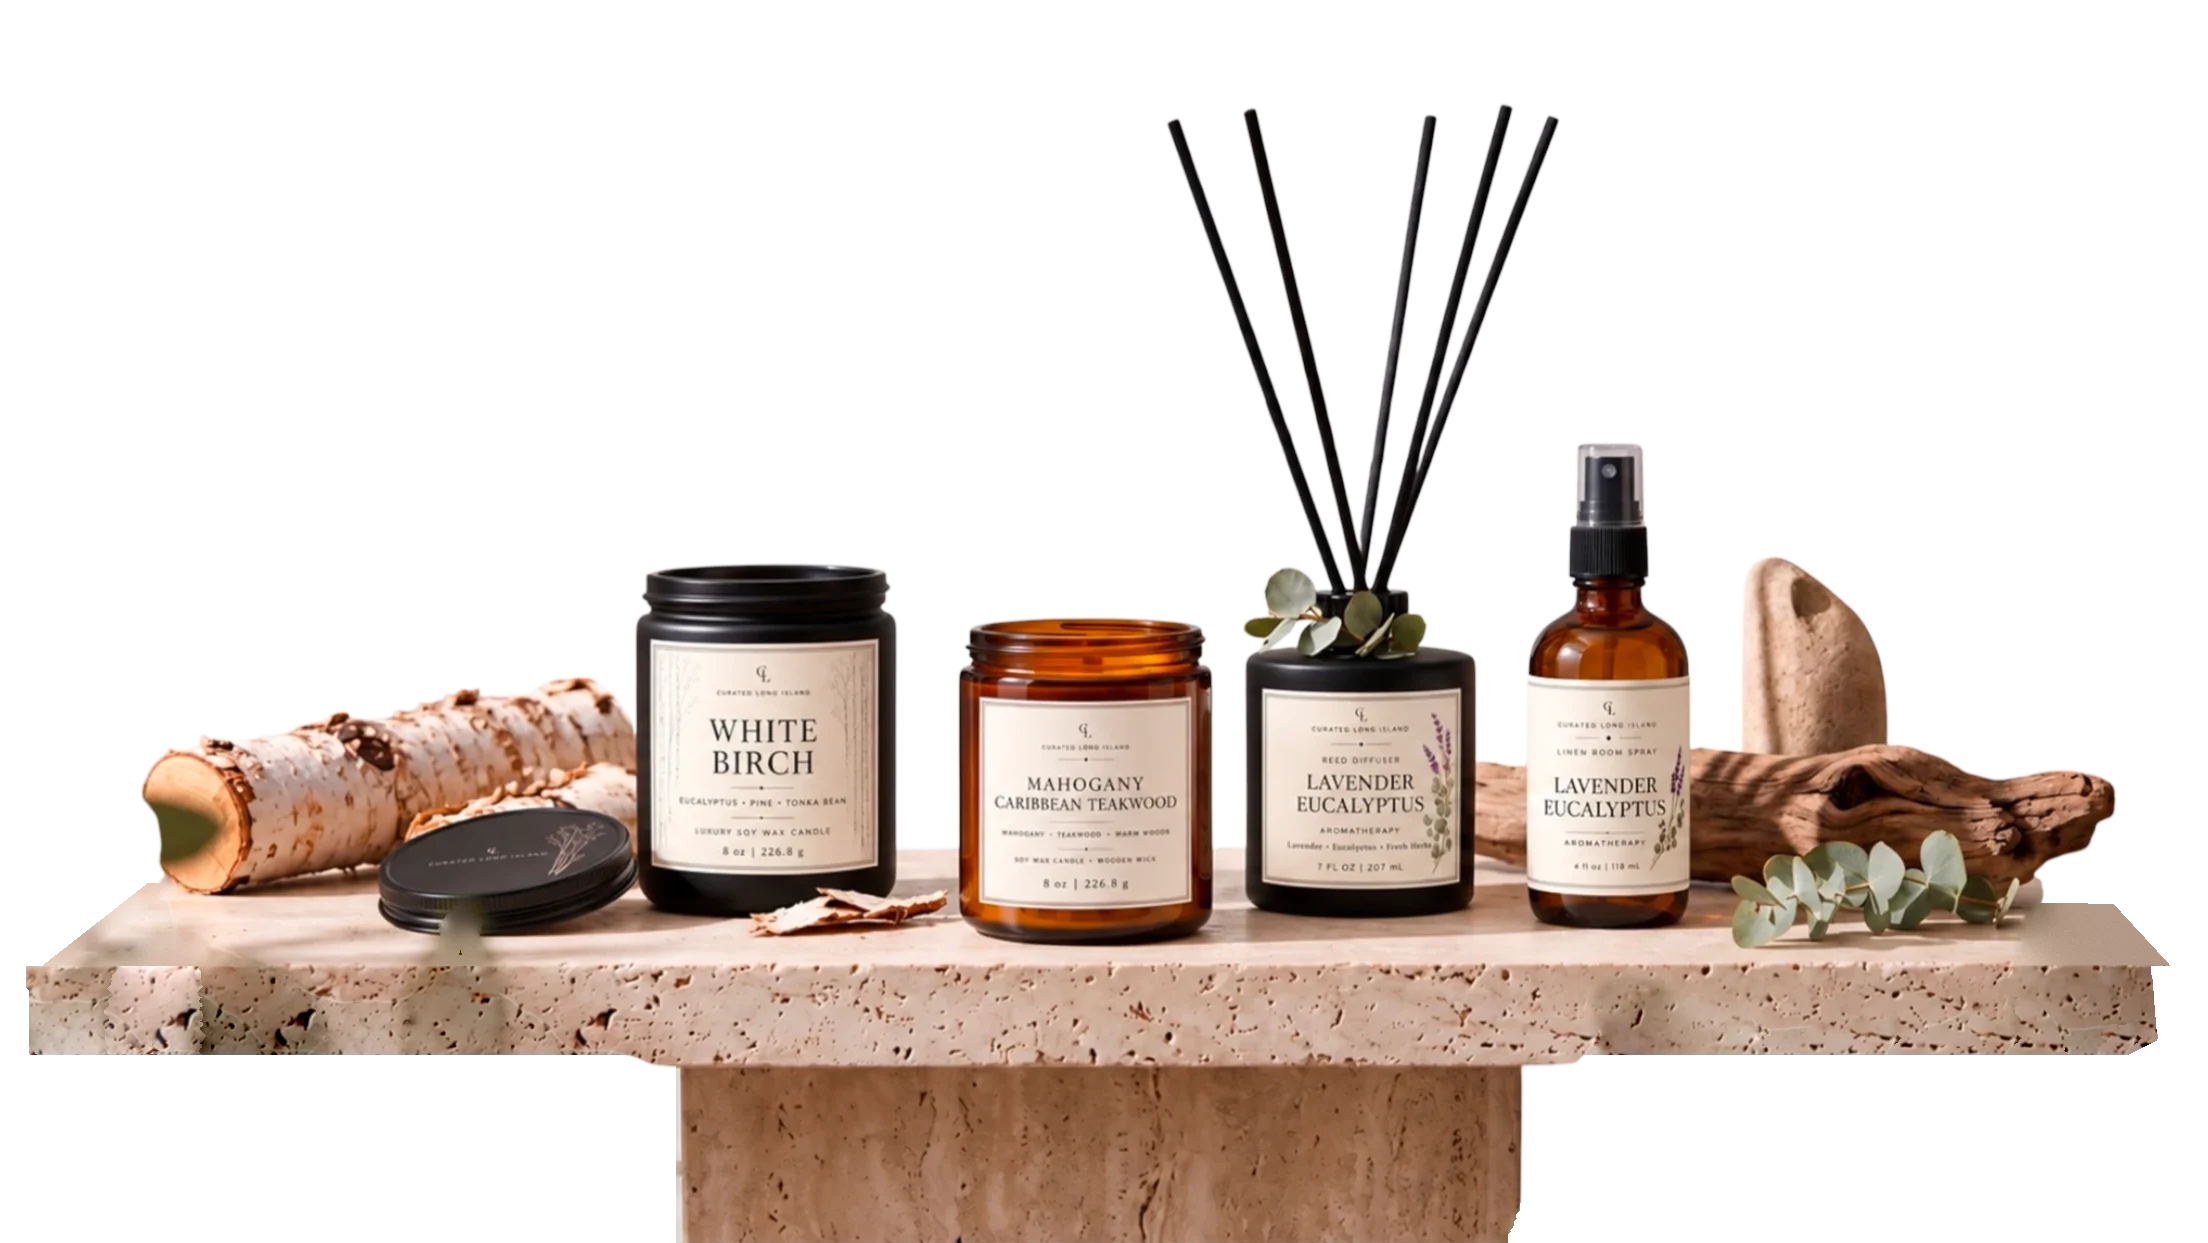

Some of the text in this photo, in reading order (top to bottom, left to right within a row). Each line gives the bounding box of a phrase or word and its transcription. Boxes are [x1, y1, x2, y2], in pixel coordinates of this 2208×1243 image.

[710, 718, 817, 743] WHITE
[713, 751, 813, 775] BIRCH
[1027, 777, 1144, 791] MAHOGANY
[1307, 774, 1414, 791] LAVENDER
[1555, 777, 1657, 794] LAVENDER
[679, 797, 737, 807] EUCALYPTUS
[786, 799, 819, 807] TONKA
[994, 795, 1177, 811] CARIBBEAN TEAKWOOD
[1297, 796, 1424, 813] EUCALYPTUS
[1544, 799, 1666, 817] EUCALYPTUS
[695, 828, 731, 836] LUXURY
[791, 828, 830, 836] CANDLE
[723, 847, 729, 856] 8
[761, 847, 793, 857] 226.8
[798, 849, 804, 858] g
[1287, 841, 1322, 849] Lavender
[1043, 879, 1049, 888] 8
[1085, 879, 1117, 888] 226.8
[1123, 881, 1128, 890] g
